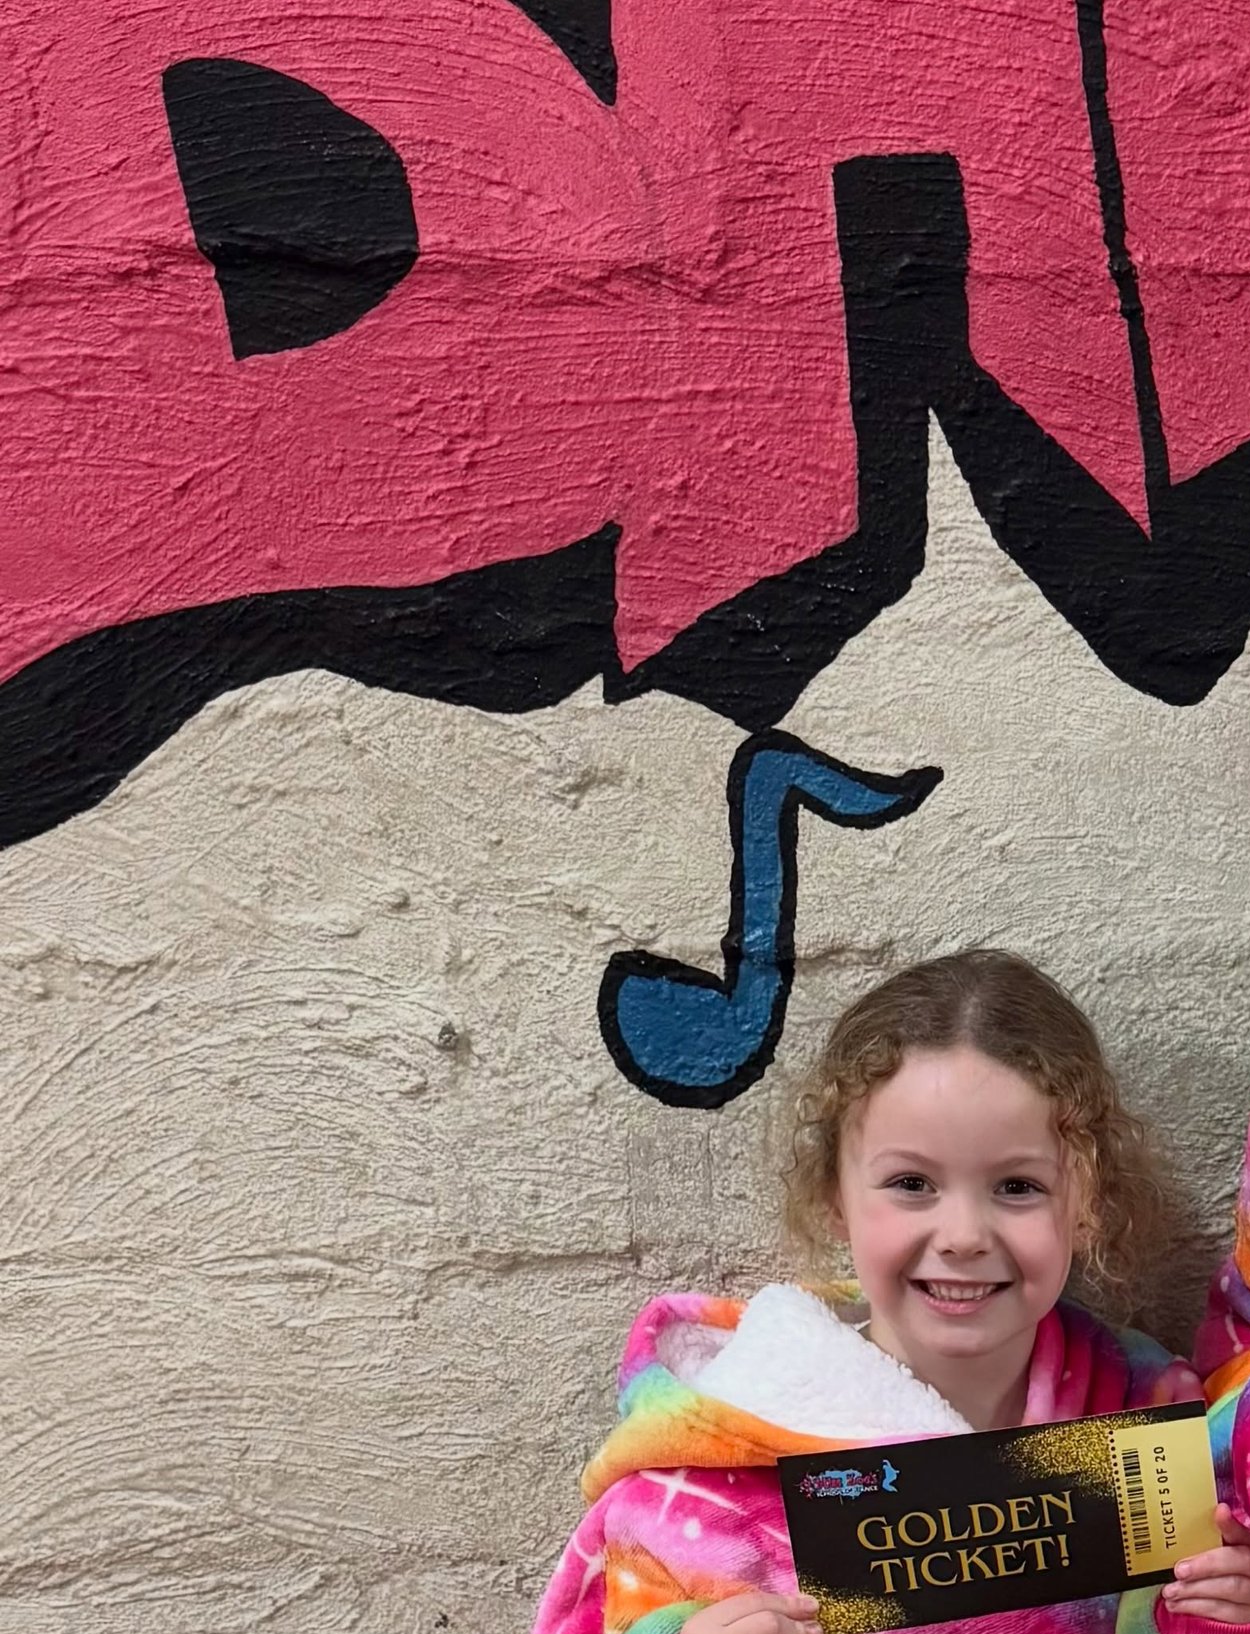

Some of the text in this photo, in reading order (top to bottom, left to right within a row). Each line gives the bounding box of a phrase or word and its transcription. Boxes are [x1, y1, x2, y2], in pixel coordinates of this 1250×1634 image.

[856, 1490, 1077, 1551] GOLDEN
[1152, 1445, 1178, 1551] TICKET 5 OF 20
[869, 1534, 1071, 1594] TICKET!
